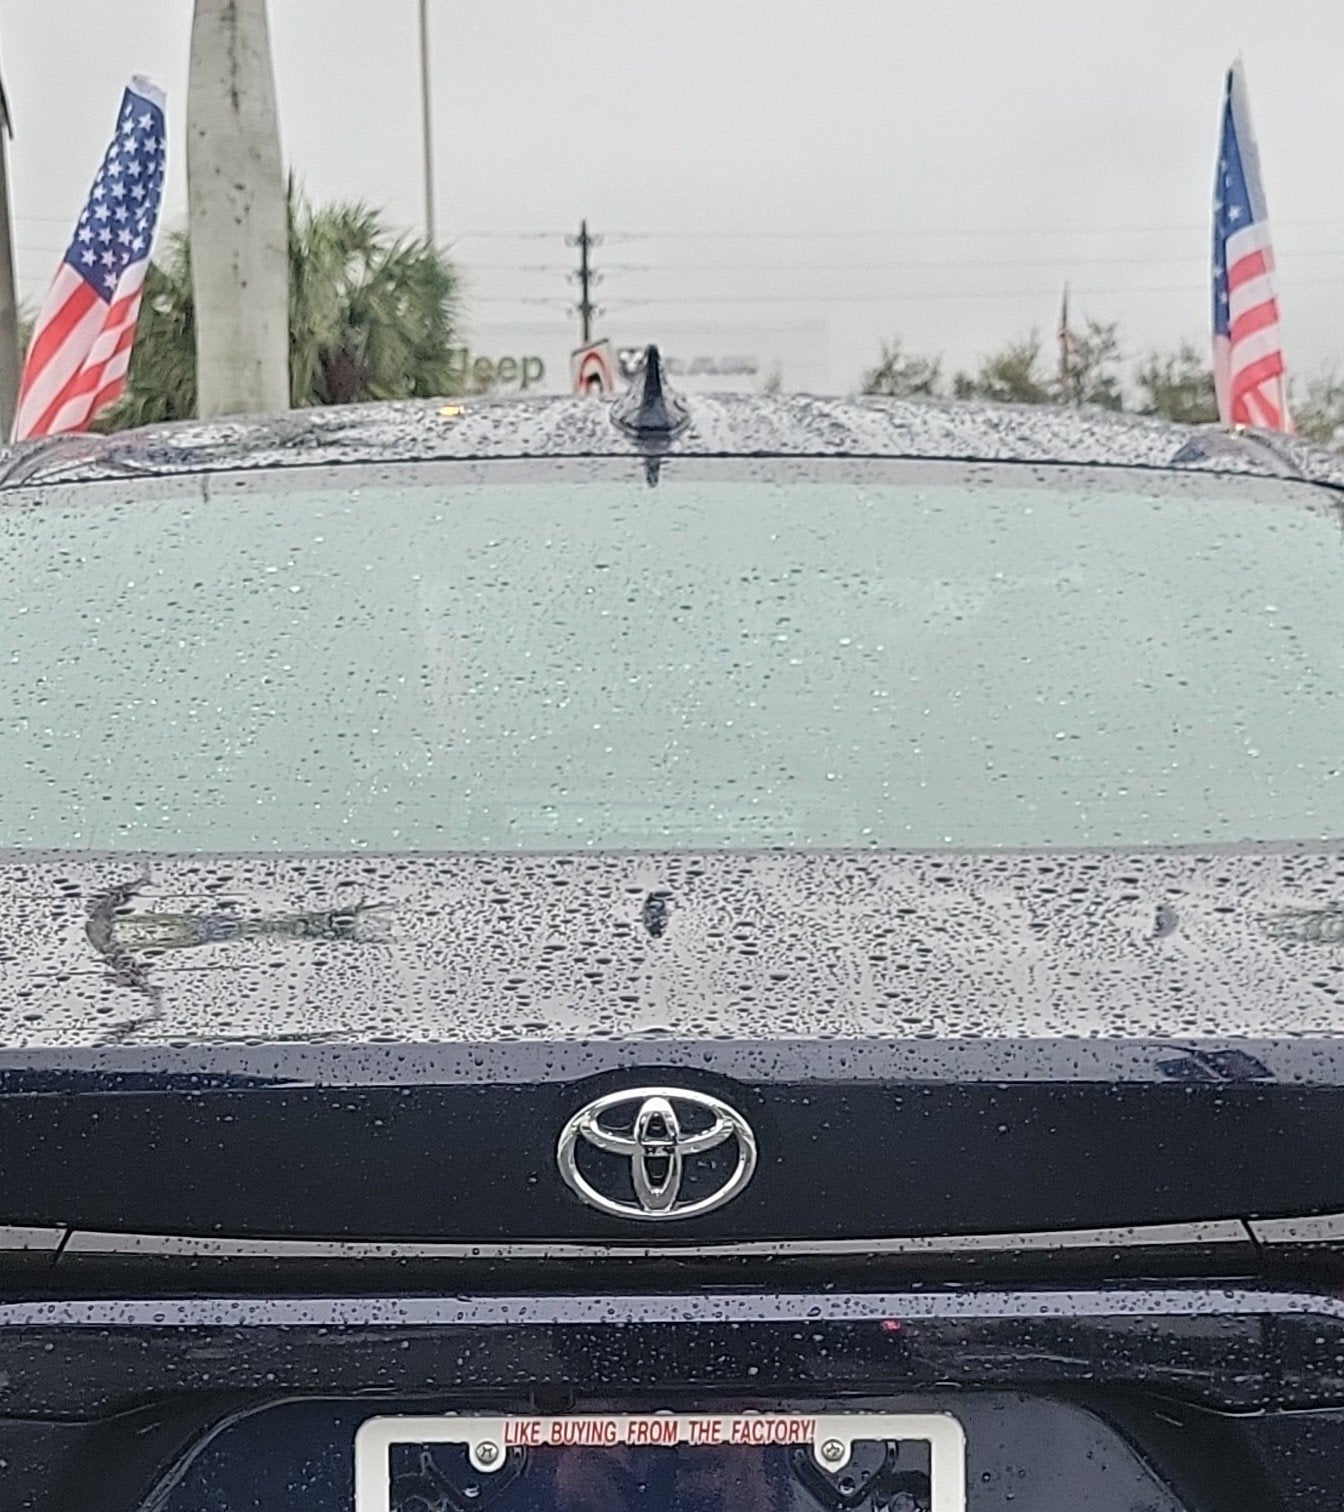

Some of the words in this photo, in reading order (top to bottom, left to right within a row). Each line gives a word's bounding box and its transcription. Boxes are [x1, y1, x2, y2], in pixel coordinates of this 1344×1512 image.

[505, 1421, 541, 1443] LIKE
[551, 1420, 617, 1443] BUYING
[627, 1420, 679, 1443] FROM
[689, 1420, 722, 1443] THE
[731, 1419, 816, 1443] FACTORY!
